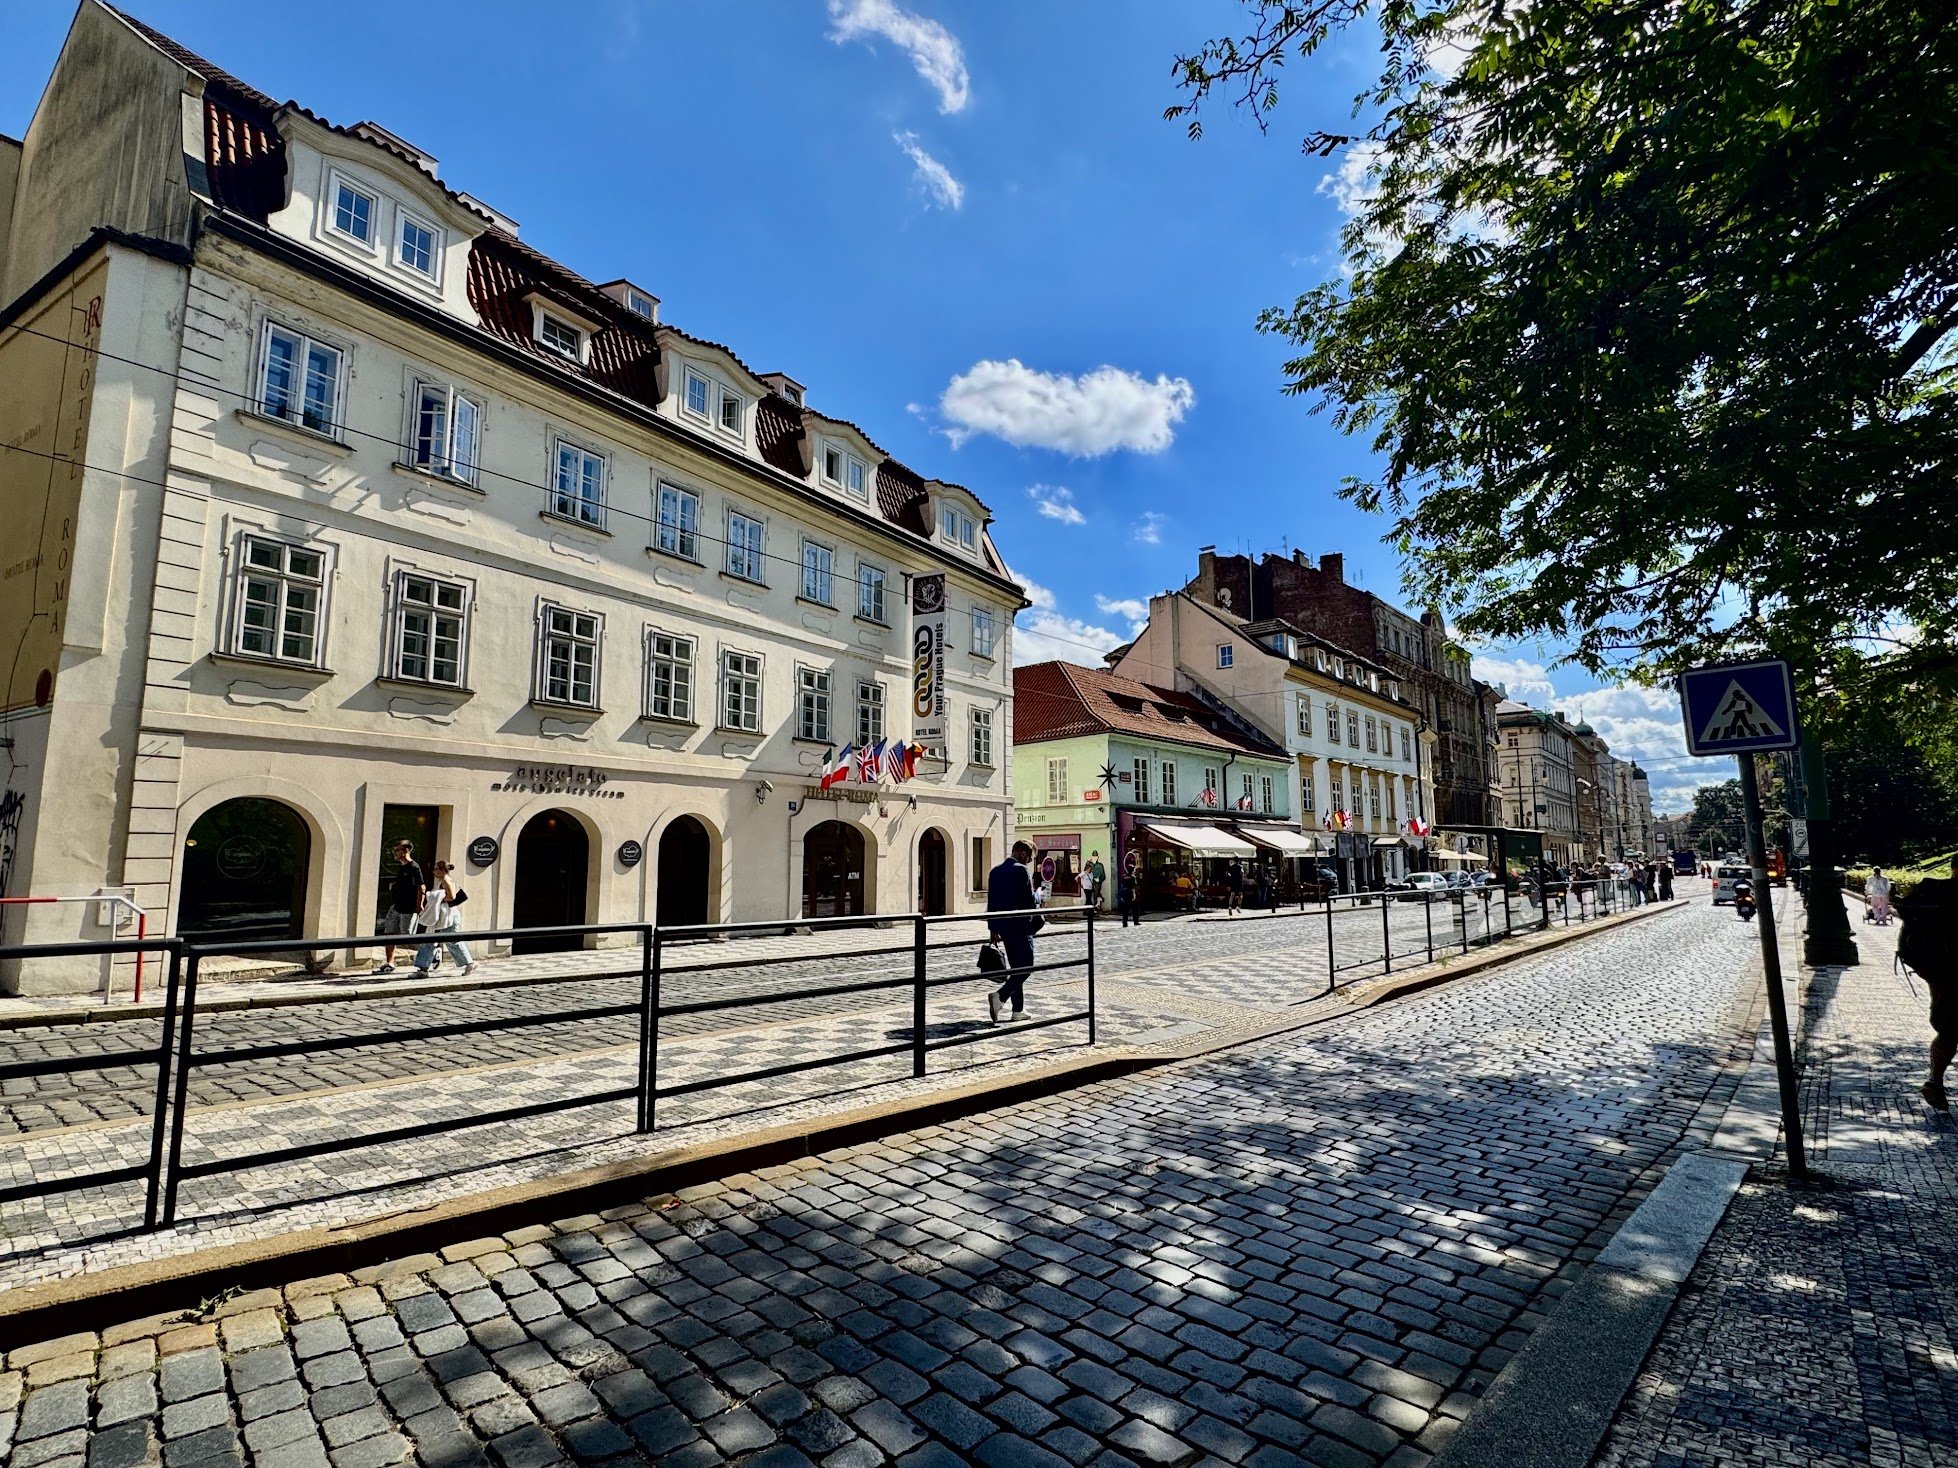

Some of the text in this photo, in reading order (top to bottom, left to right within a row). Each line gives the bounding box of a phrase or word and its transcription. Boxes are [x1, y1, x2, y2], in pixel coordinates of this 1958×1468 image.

[50, 337, 94, 635] HOTEL ROMA
[934, 622, 945, 717] Your Prague Hotels
[1016, 813, 1047, 825] Penzion
